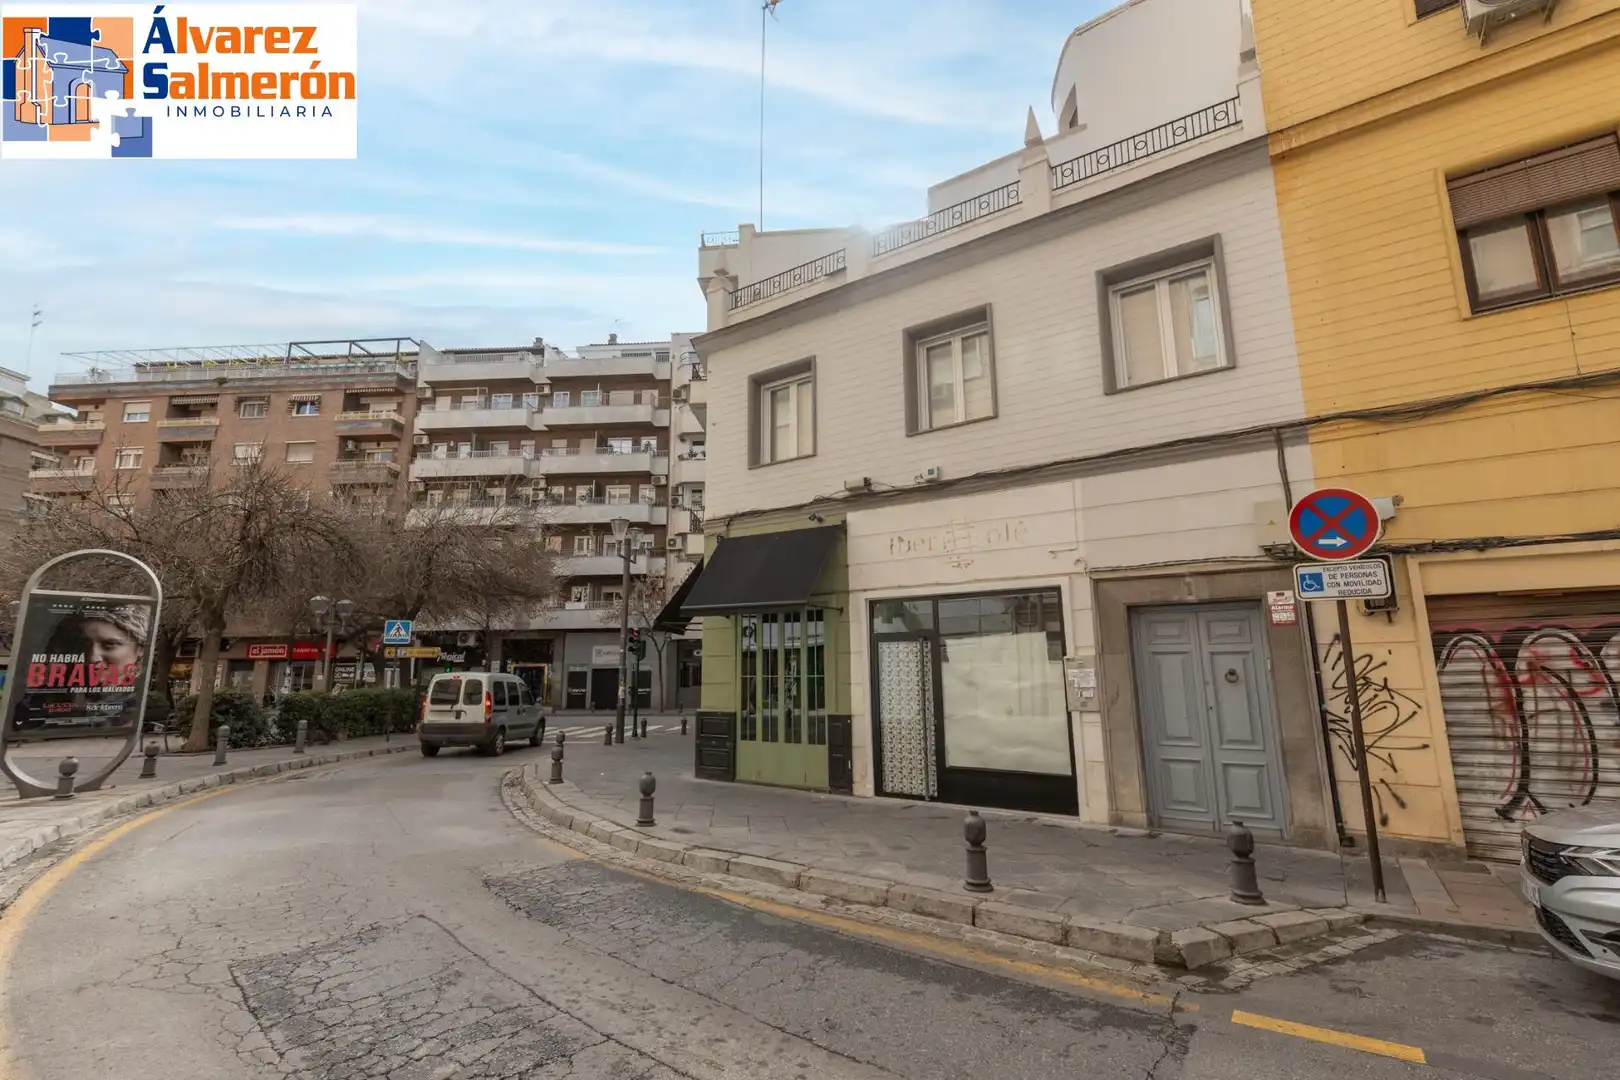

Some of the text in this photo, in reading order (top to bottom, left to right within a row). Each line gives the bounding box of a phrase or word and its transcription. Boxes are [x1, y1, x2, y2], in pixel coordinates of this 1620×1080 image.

[1340, 571, 1378, 579] PERSONAS
[1343, 579, 1382, 587] MOVILIDAD
[1337, 588, 1373, 596] REDUCIDA
[31, 652, 85, 663] NO HABRÁ
[26, 663, 137, 688] BRAVAS
